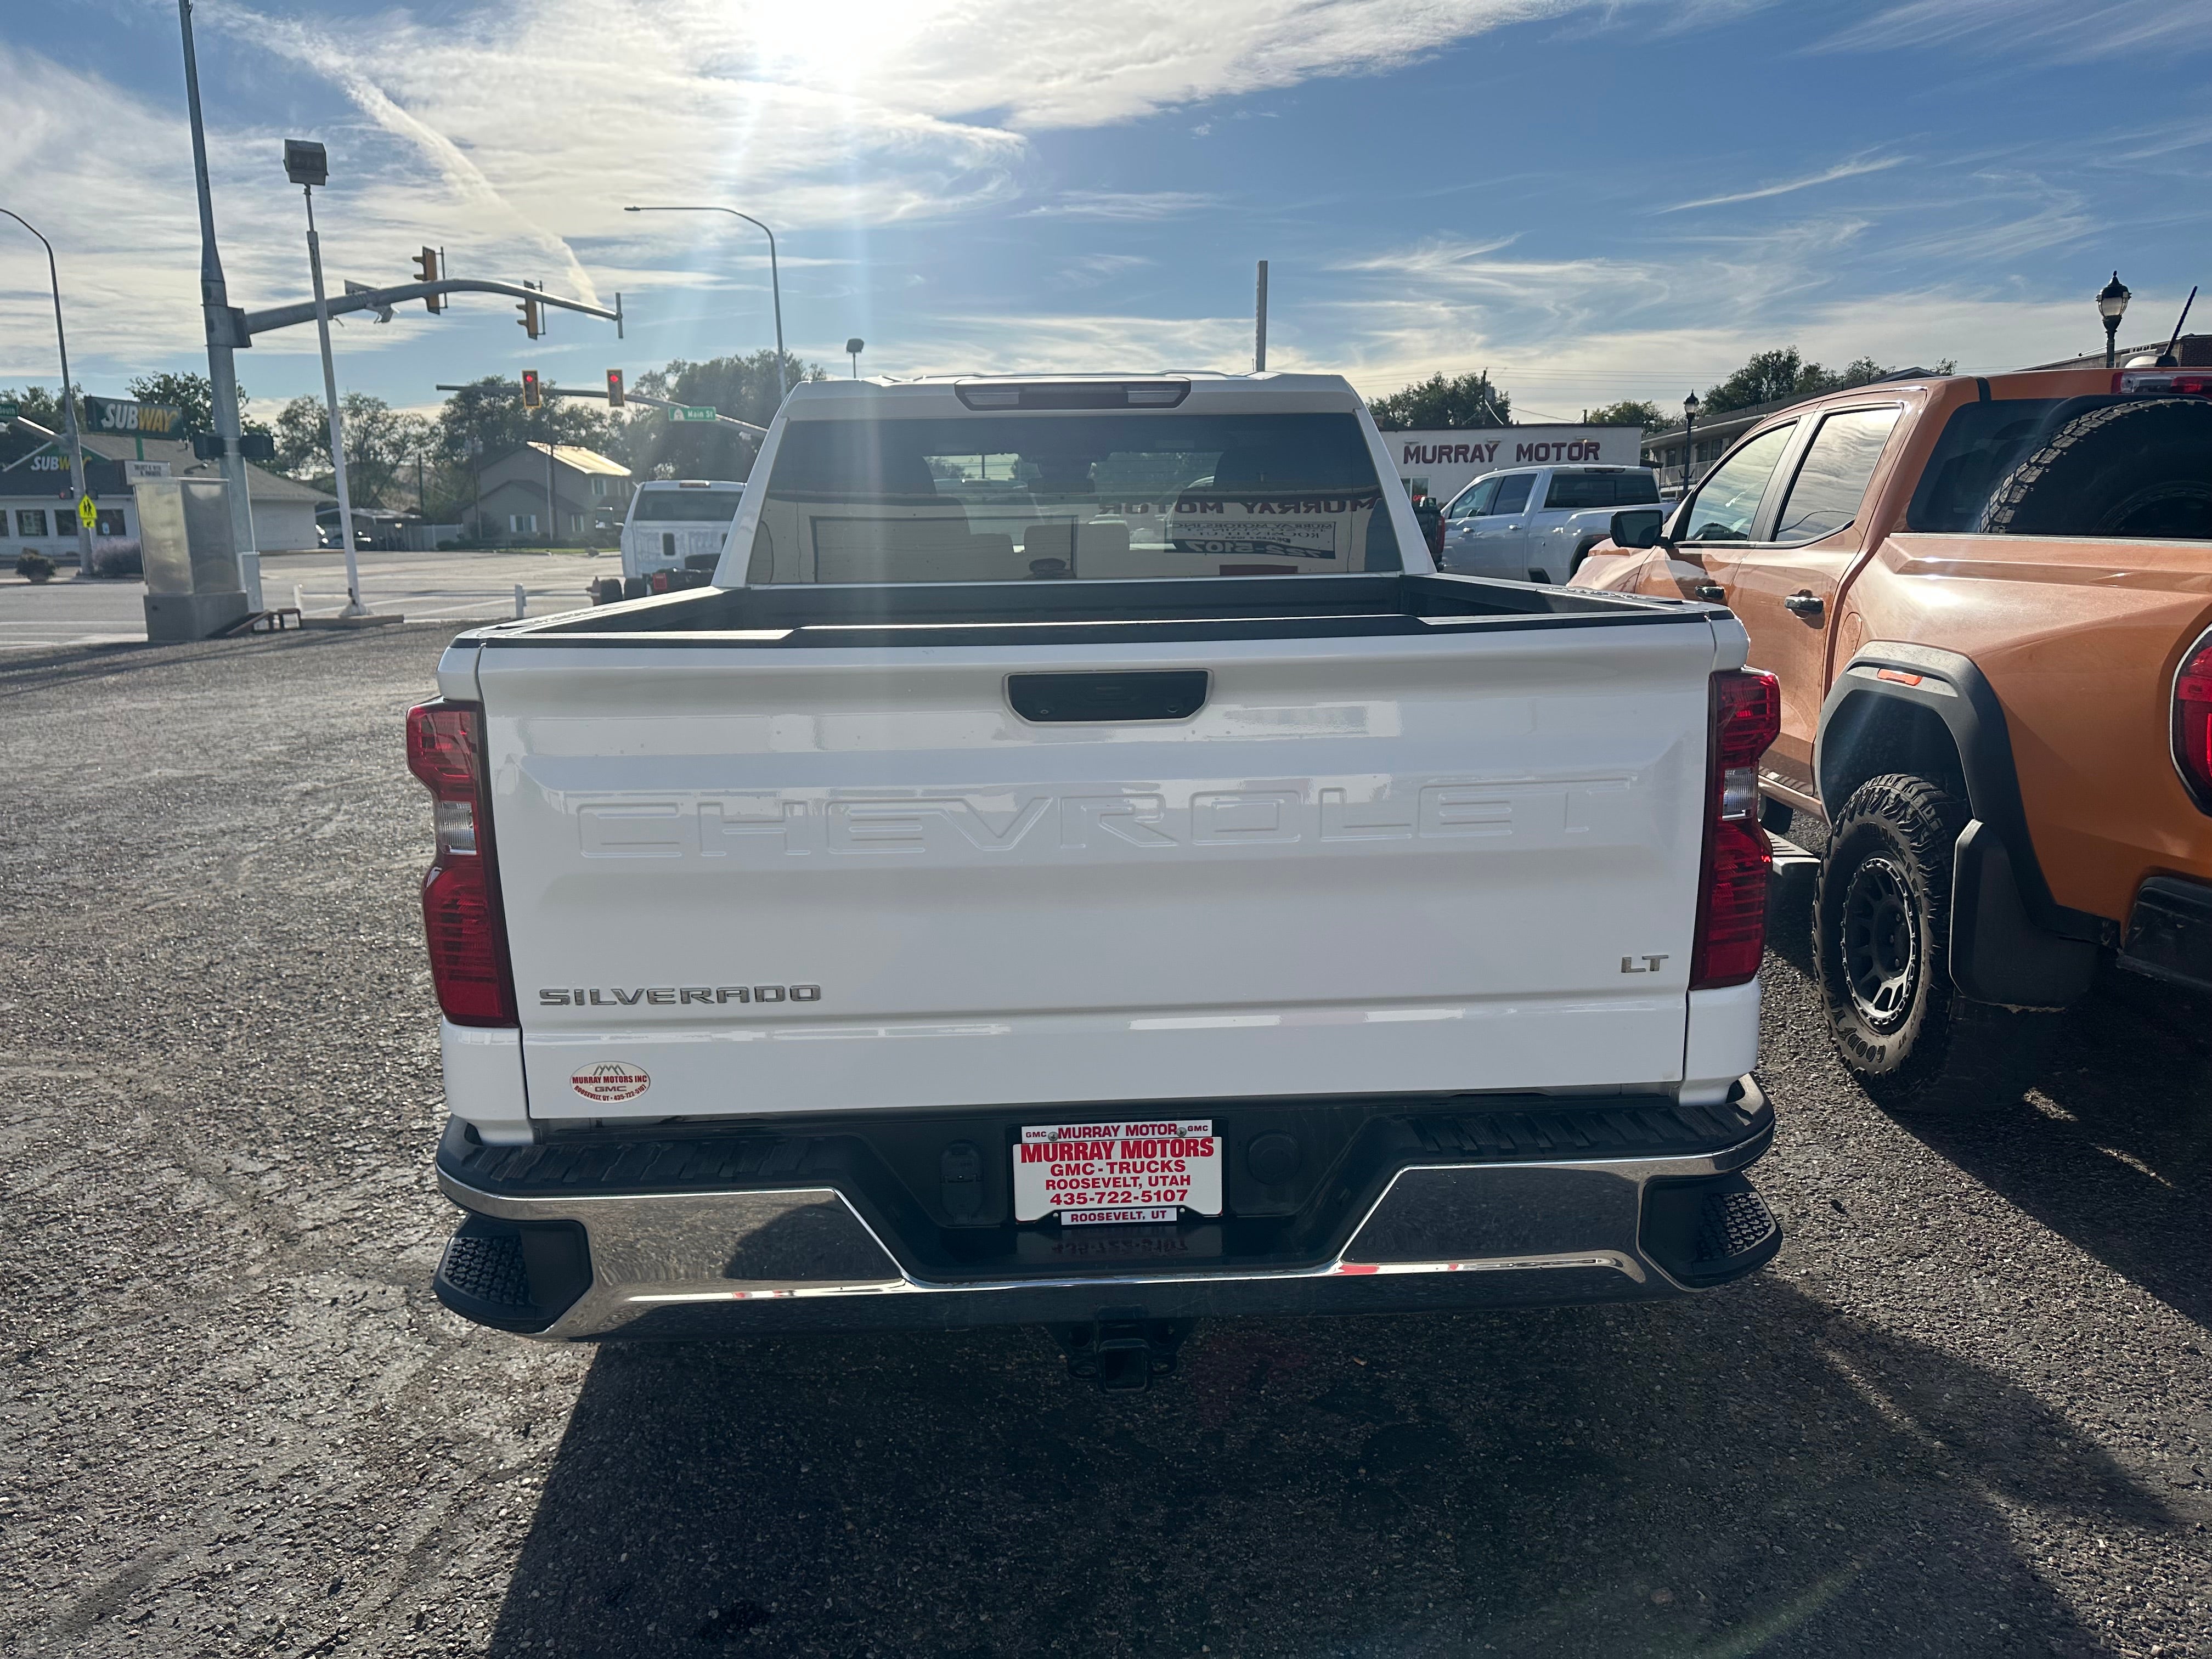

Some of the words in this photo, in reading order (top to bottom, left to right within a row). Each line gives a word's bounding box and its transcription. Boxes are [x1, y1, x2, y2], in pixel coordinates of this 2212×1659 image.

[101, 403, 178, 433] SUBWAY
[1403, 444, 1498, 464] MURRAY
[1516, 442, 1600, 462] MOTOR
[31, 456, 92, 471] SUBW
[576, 777, 1630, 858] CHEVROLET
[1621, 955, 1669, 973] LT
[539, 985, 821, 1006] SILVERADO
[572, 1076, 602, 1084] MURRAY
[603, 1075, 633, 1084] MOTORS
[613, 1084, 647, 1101] 435-722-5107
[1058, 1125, 1120, 1139] MURRAY
[1126, 1124, 1177, 1136] MOTOR
[1020, 1141, 1116, 1163] MURRAY
[1121, 1138, 1214, 1159] MOTORS
[1046, 1177, 1143, 1190] ROOSEVELT,
[1148, 1175, 1191, 1187] UTAH
[1050, 1189, 1188, 1205] 435-722-5107
[1071, 1211, 1146, 1222] ROOSEVELT,
[1152, 1210, 1167, 1220] UT
